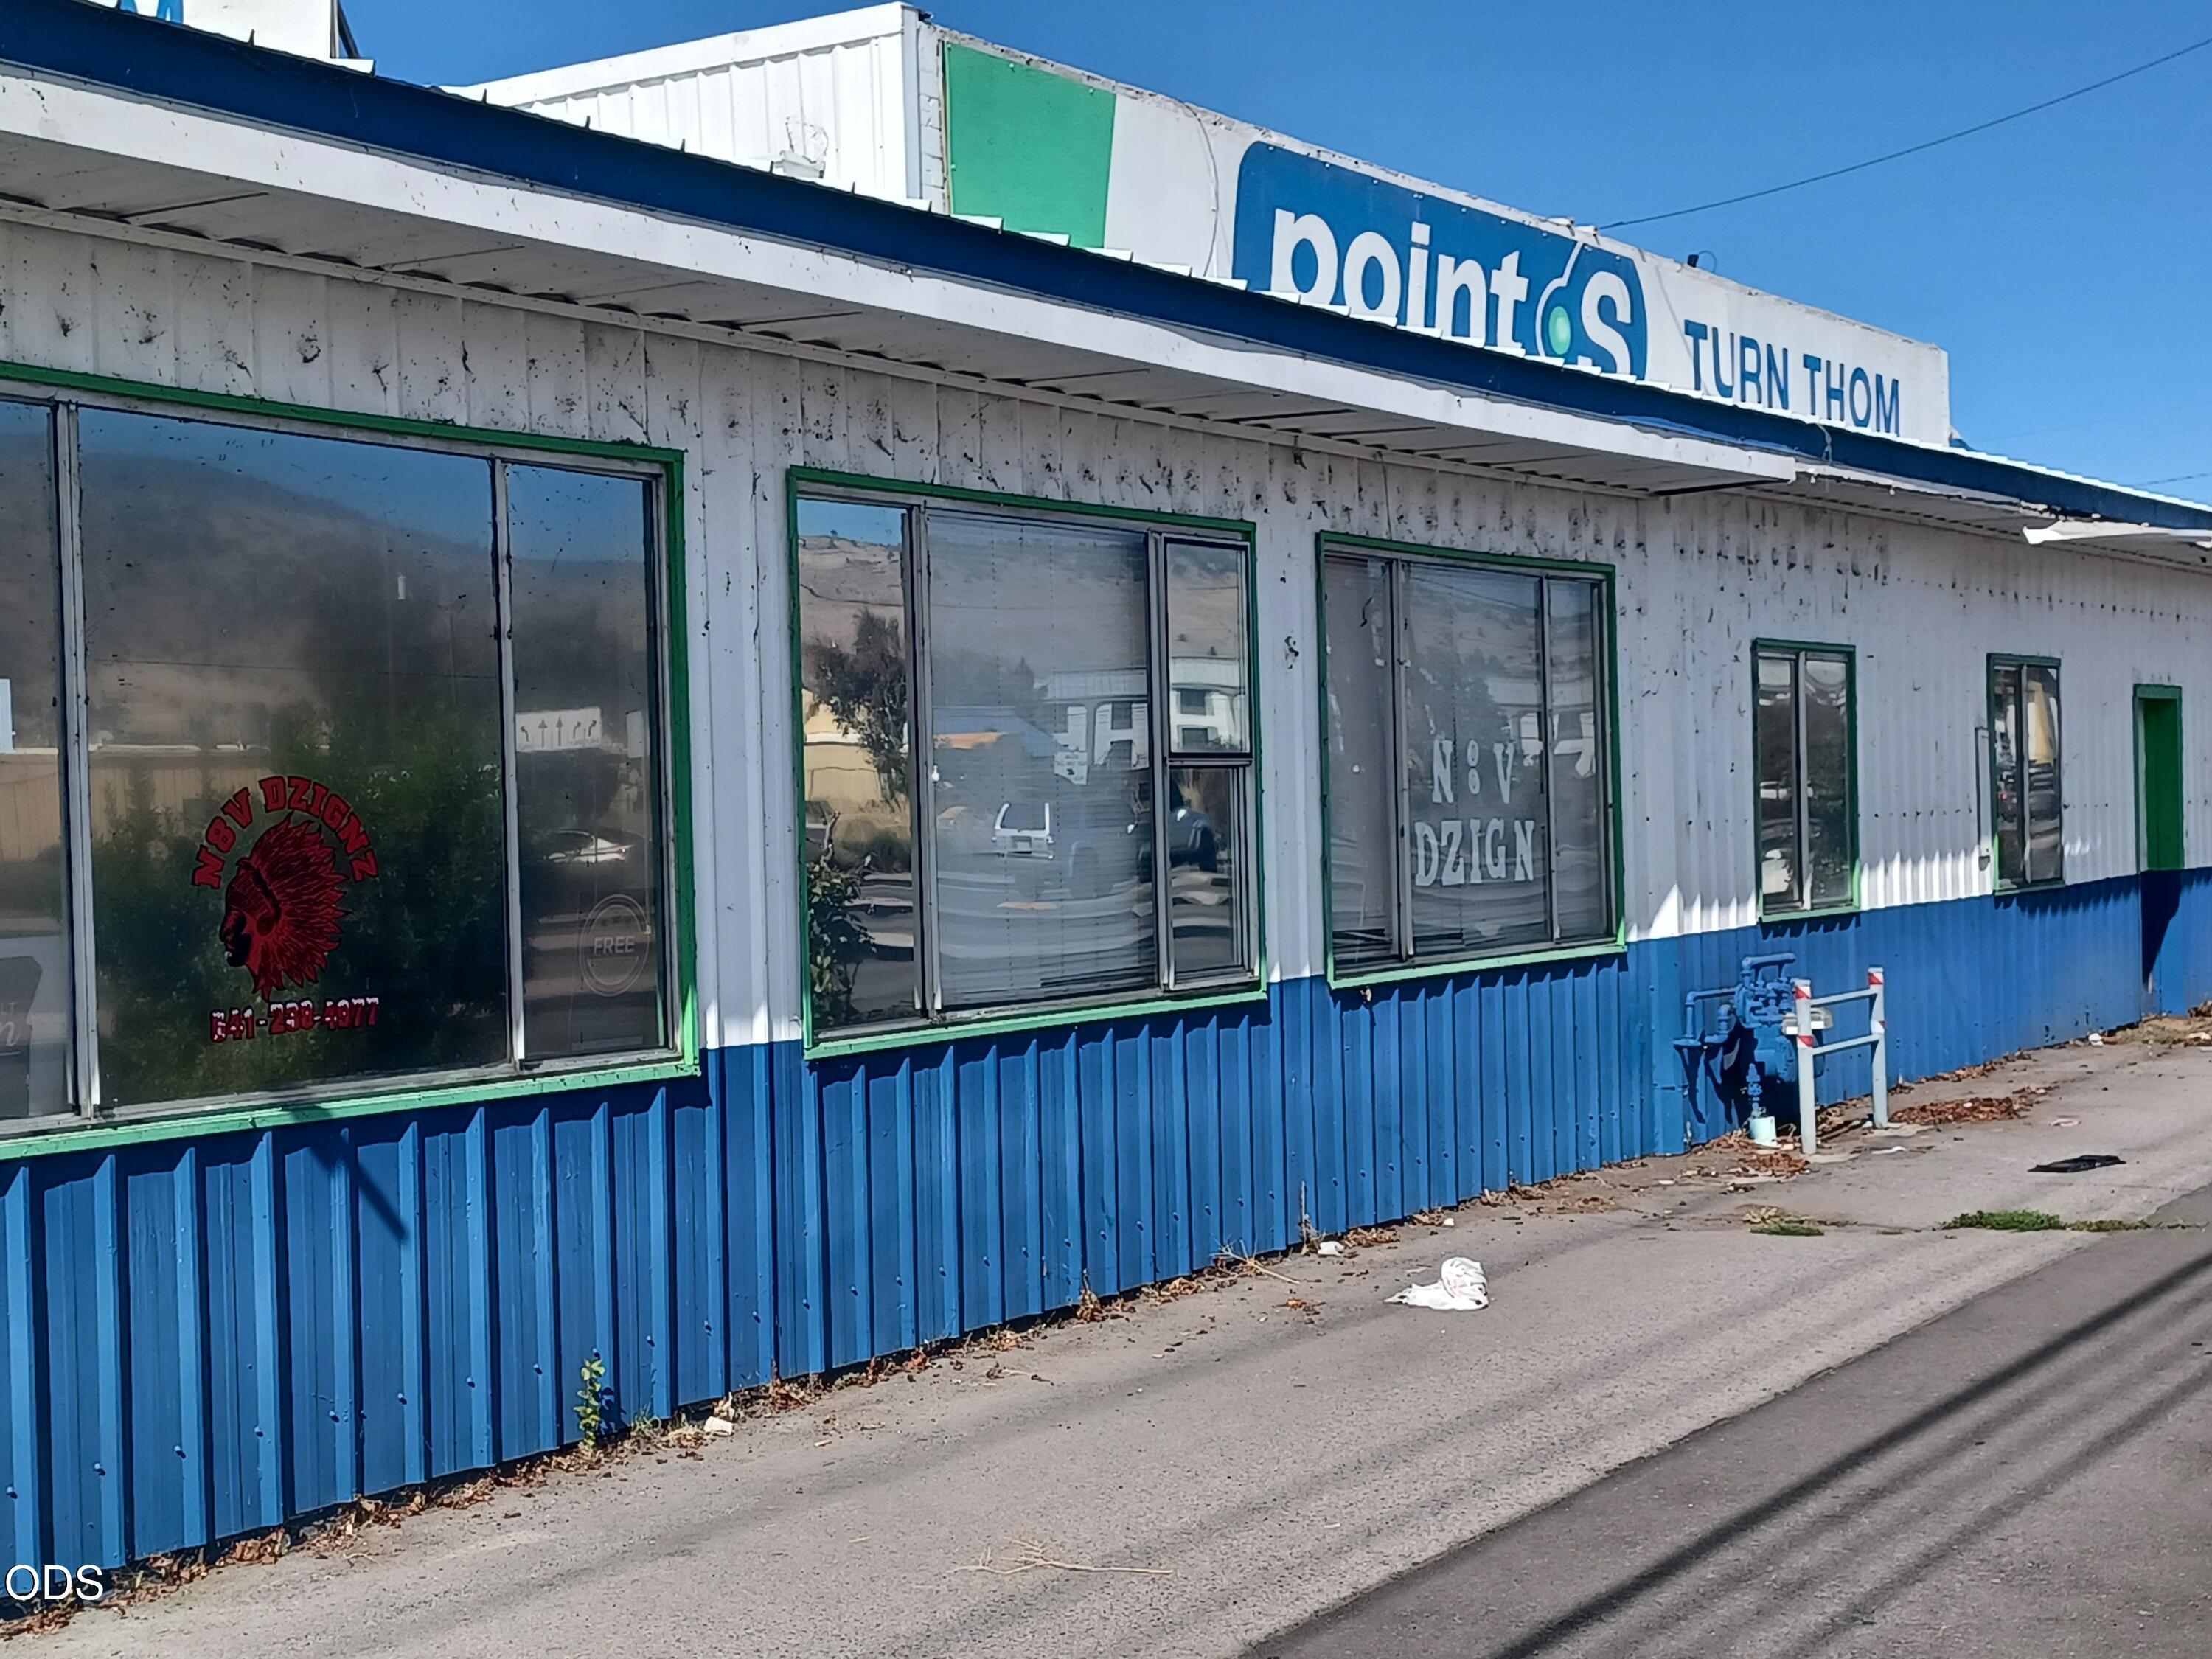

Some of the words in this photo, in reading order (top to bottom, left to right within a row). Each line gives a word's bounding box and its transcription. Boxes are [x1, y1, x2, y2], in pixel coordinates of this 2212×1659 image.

[1270, 209, 1528, 348] point
[1684, 319, 1789, 410] TURN
[1803, 354, 1900, 437] THOM
[192, 787, 253, 889] N8V
[259, 776, 378, 883] DZIGNZ
[1414, 818, 1534, 886] DZIGN
[594, 935, 635, 956] FREE
